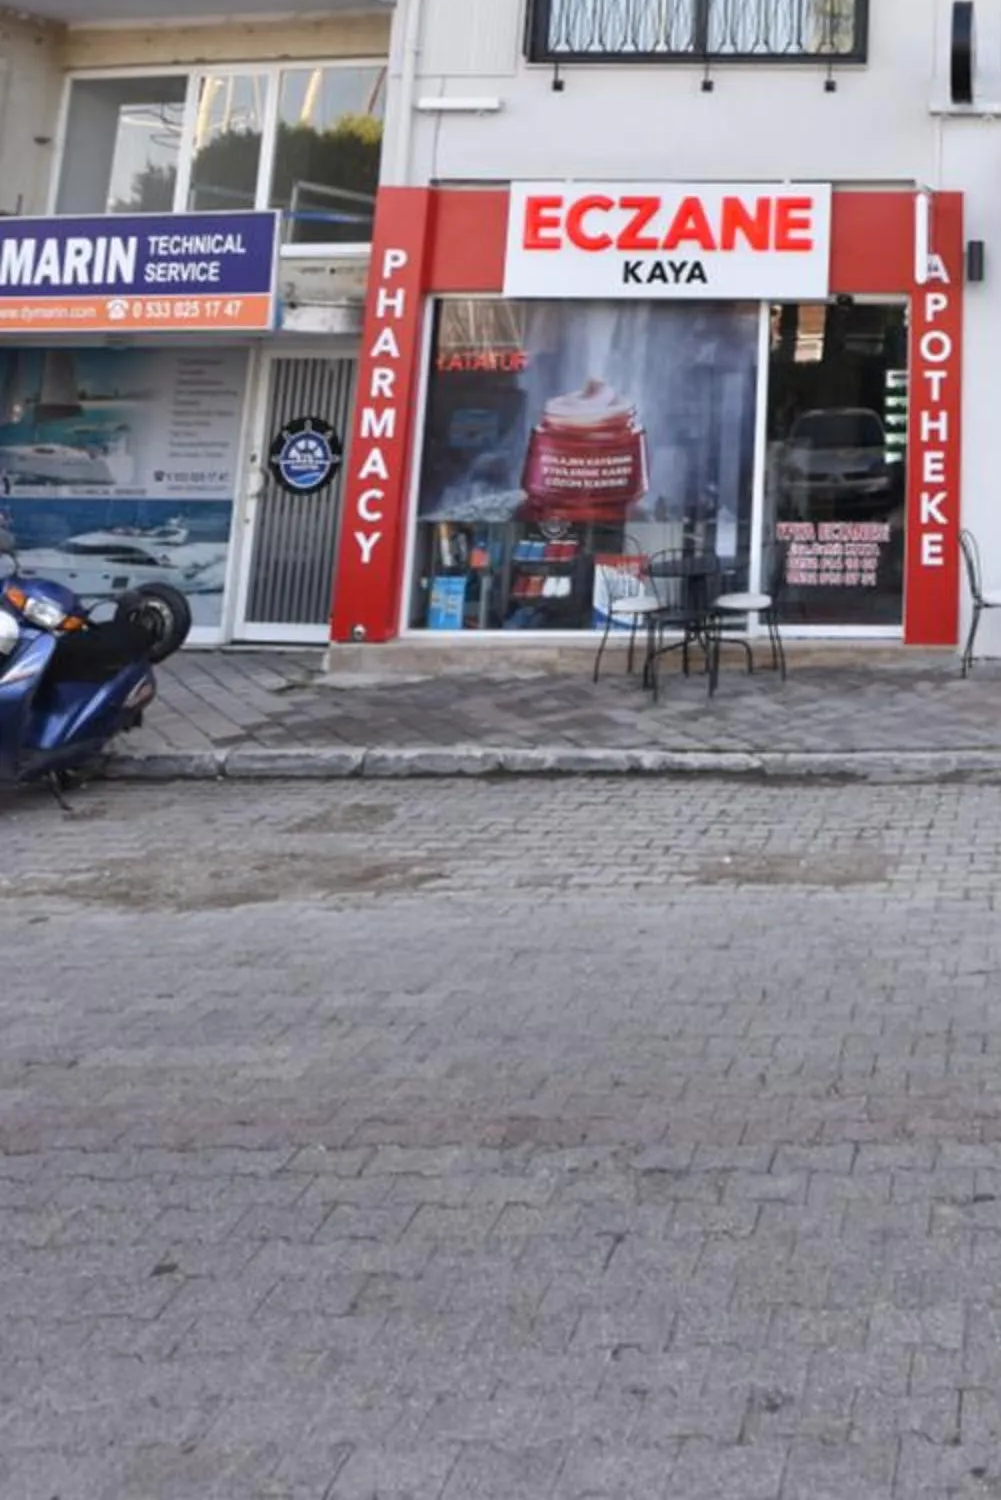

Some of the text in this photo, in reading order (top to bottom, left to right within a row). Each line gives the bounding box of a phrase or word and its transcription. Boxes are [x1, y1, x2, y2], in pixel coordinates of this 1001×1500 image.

[523, 196, 813, 252] ECZANE
[0, 234, 246, 286] MARIN TECHNICAL
[144, 262, 220, 282] SERVICE
[622, 260, 709, 285] KAYA
[204, 301, 222, 318] 17
[223, 300, 243, 318] 47
[350, 248, 407, 565] PHARMACY
[917, 253, 953, 567] APOTHEKE
